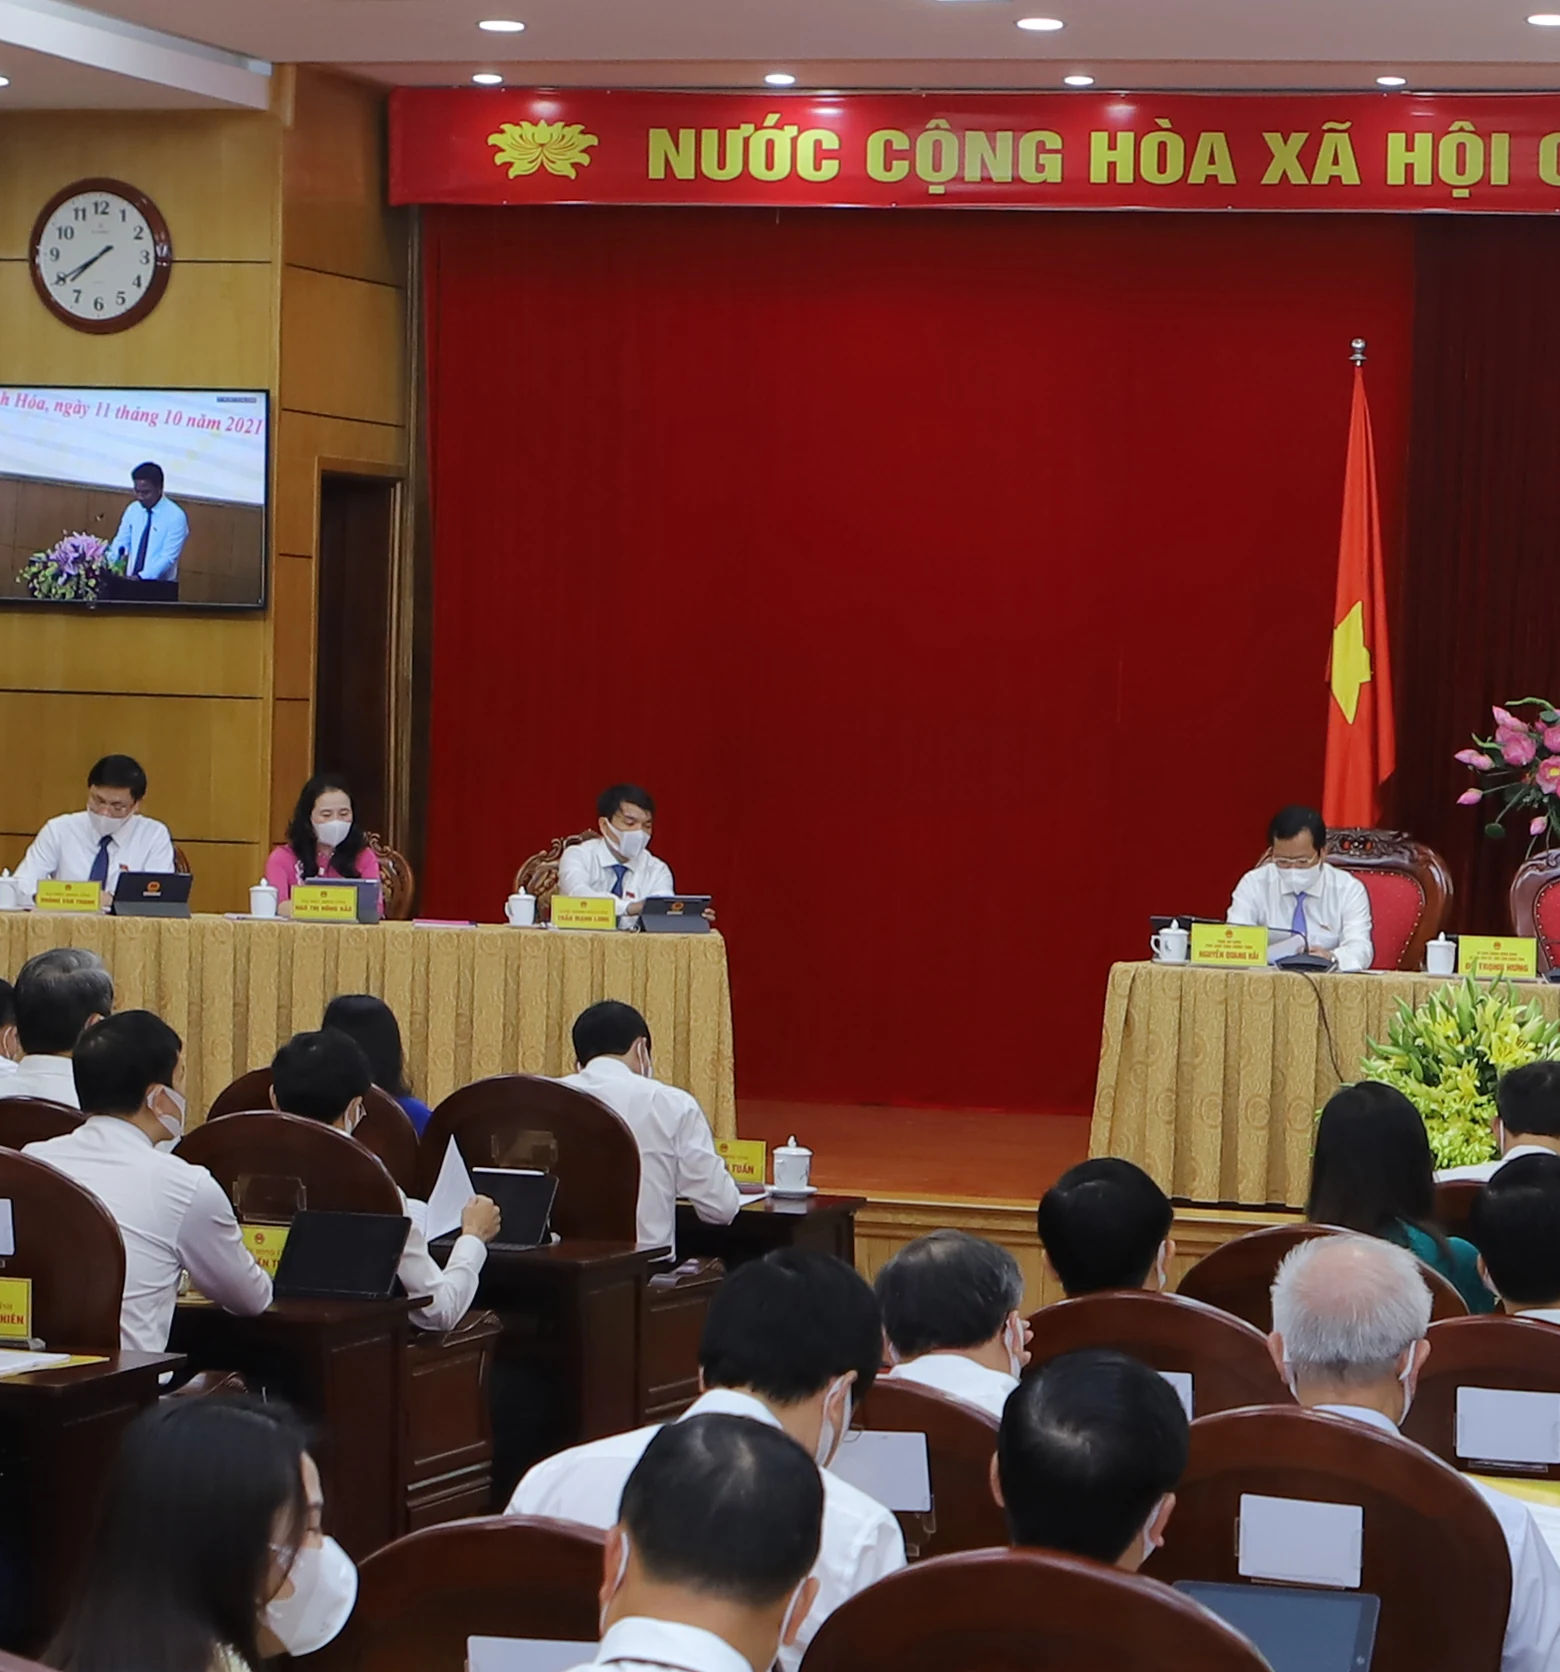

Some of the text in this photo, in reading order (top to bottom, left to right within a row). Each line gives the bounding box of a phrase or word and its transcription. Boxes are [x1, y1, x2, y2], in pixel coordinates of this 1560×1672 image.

[648, 113, 841, 182] NƯỚC
[866, 118, 1063, 195] CỘNG
[1089, 118, 1237, 185] HÒA
[1261, 121, 1361, 185] XÃ
[1386, 119, 1510, 198] HỘI
[72, 207, 88, 222] 11
[91, 200, 111, 216] 12
[119, 208, 128, 223] 1
[55, 225, 75, 241] 10
[132, 225, 144, 241] 2
[49, 246, 60, 264] 9
[139, 249, 151, 265] 3
[131, 274, 143, 289] 4
[72, 288, 83, 304] 7
[93, 296, 105, 312] 6
[115, 290, 127, 306] 5
[14, 393, 50, 413] Hóa,
[53, 399, 91, 419] ngày
[94, 402, 111, 417] 11
[115, 404, 160, 427] tháng
[163, 409, 183, 426] 10
[185, 412, 222, 431] năm
[224, 416, 264, 436] 2021
